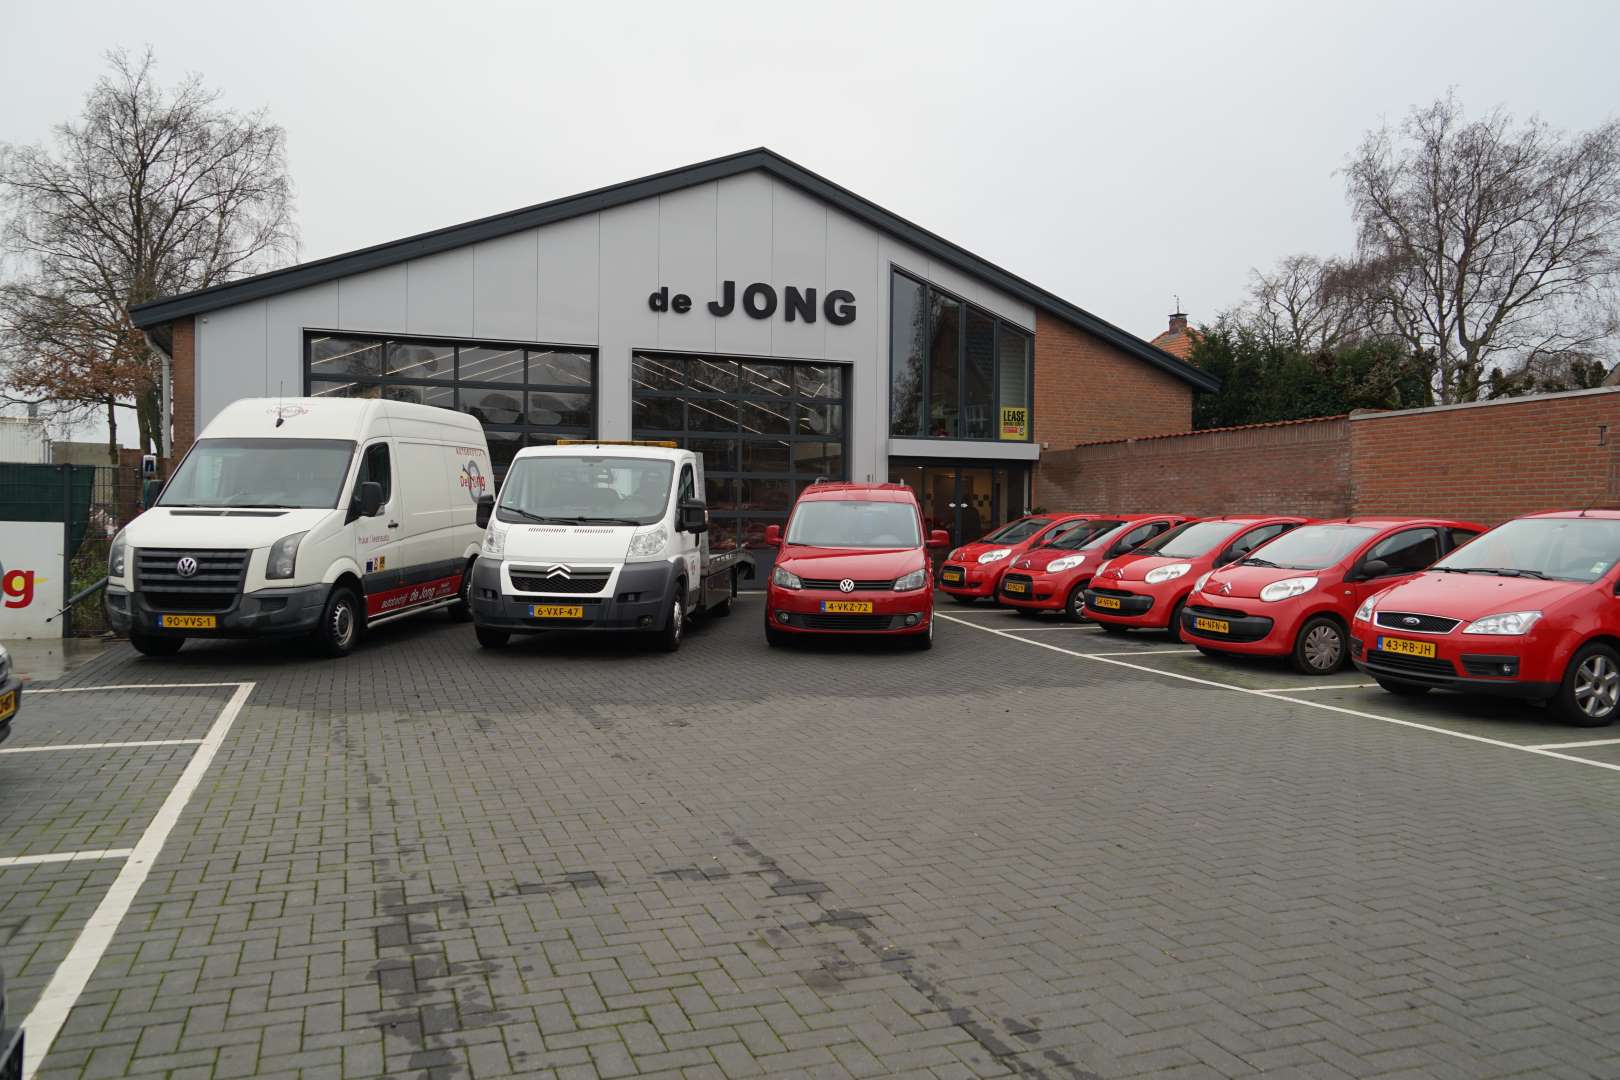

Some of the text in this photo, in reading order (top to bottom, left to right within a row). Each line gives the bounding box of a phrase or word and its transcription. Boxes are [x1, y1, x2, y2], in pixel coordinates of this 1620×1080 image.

[648, 280, 857, 326] de JONG
[1003, 410, 1025, 422] LEASE
[536, 607, 580, 617] 6-VXF-47
[828, 602, 869, 612] 4-VKZ-72
[165, 616, 213, 627] 90-VVS-1
[1386, 639, 1431, 656] 43-RB-JH
